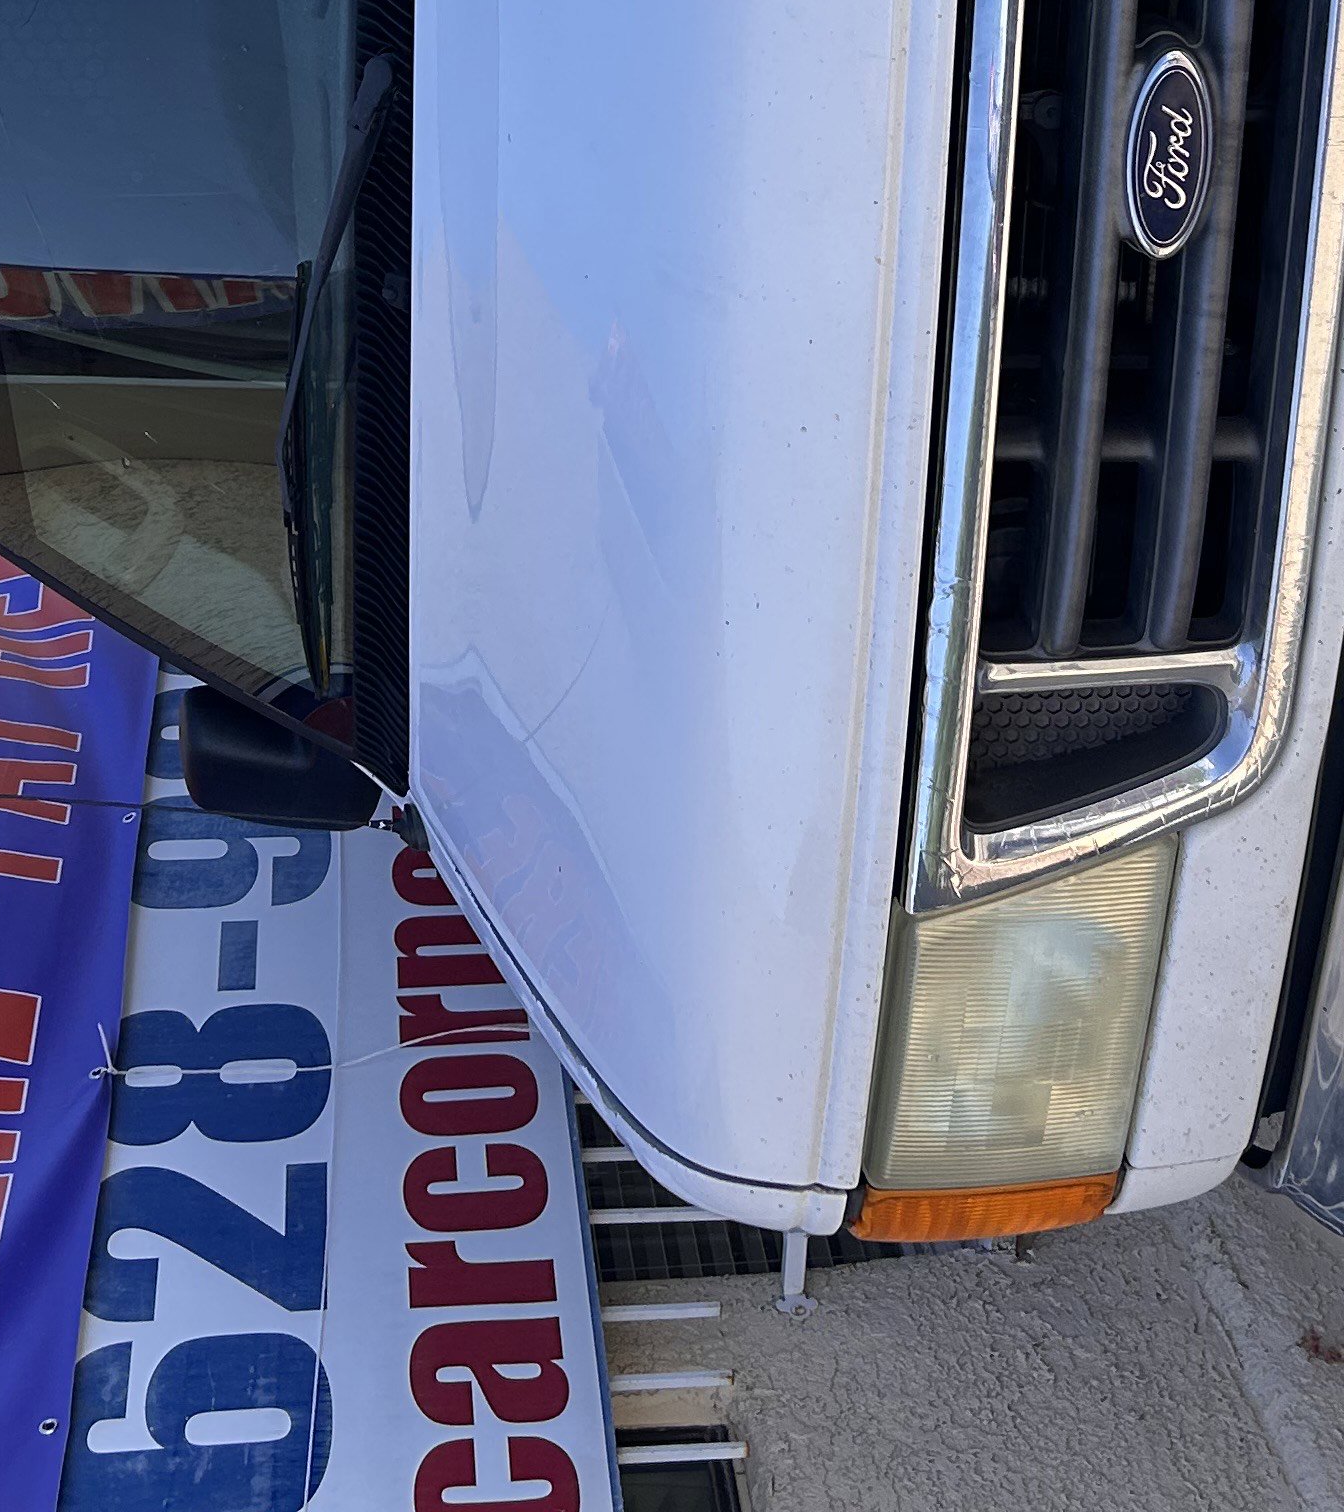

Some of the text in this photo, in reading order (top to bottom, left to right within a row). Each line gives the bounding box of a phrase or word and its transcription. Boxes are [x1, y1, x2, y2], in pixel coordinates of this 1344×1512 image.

[1142, 104, 1193, 210] Ford
[56, 659, 333, 1512] 628-9
[391, 805, 580, 1512] carcorn
